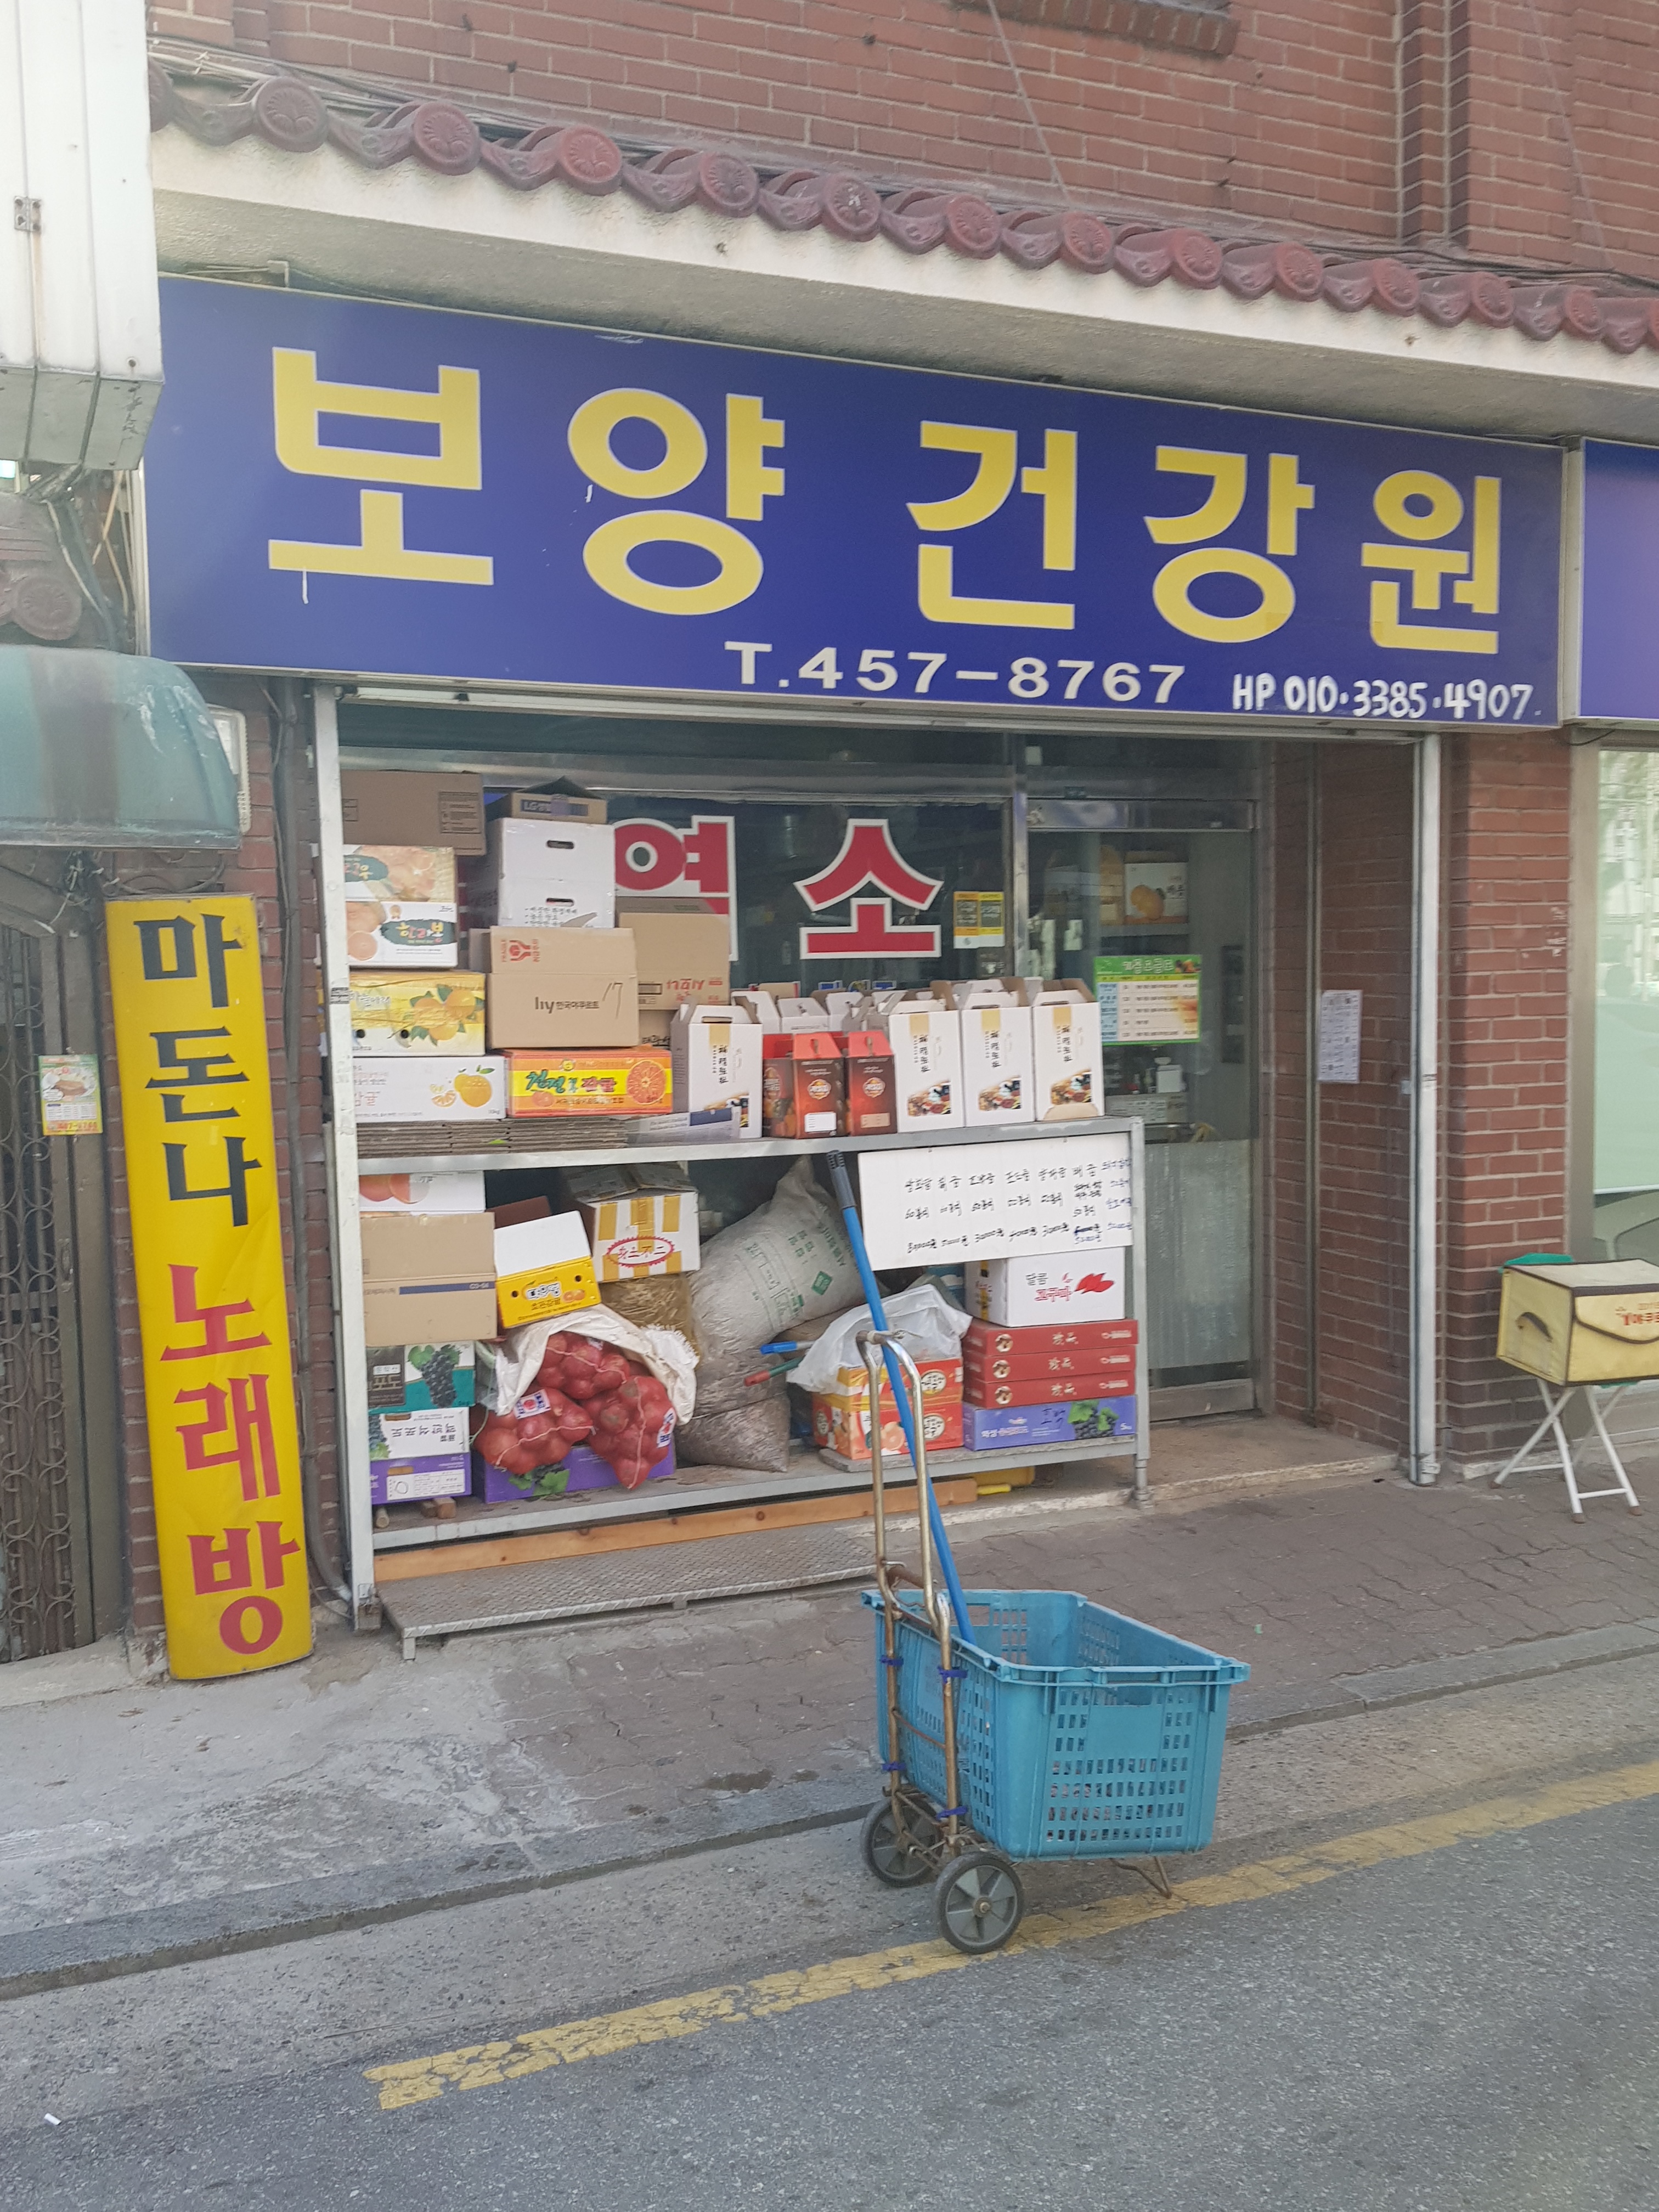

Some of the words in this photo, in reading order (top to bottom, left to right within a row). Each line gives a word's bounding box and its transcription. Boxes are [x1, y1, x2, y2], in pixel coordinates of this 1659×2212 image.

[268, 347, 786, 615] 보양
[906, 420, 1502, 654] 건강원
[1233, 673, 1276, 711] HP
[396, 922, 444, 943] 한라봉
[556, 1000, 600, 1010] 한국야쿠르트
[133, 913, 263, 1227] 마돈나
[1025, 1273, 1049, 1285] 달콤
[160, 1263, 301, 1655] 노래방
